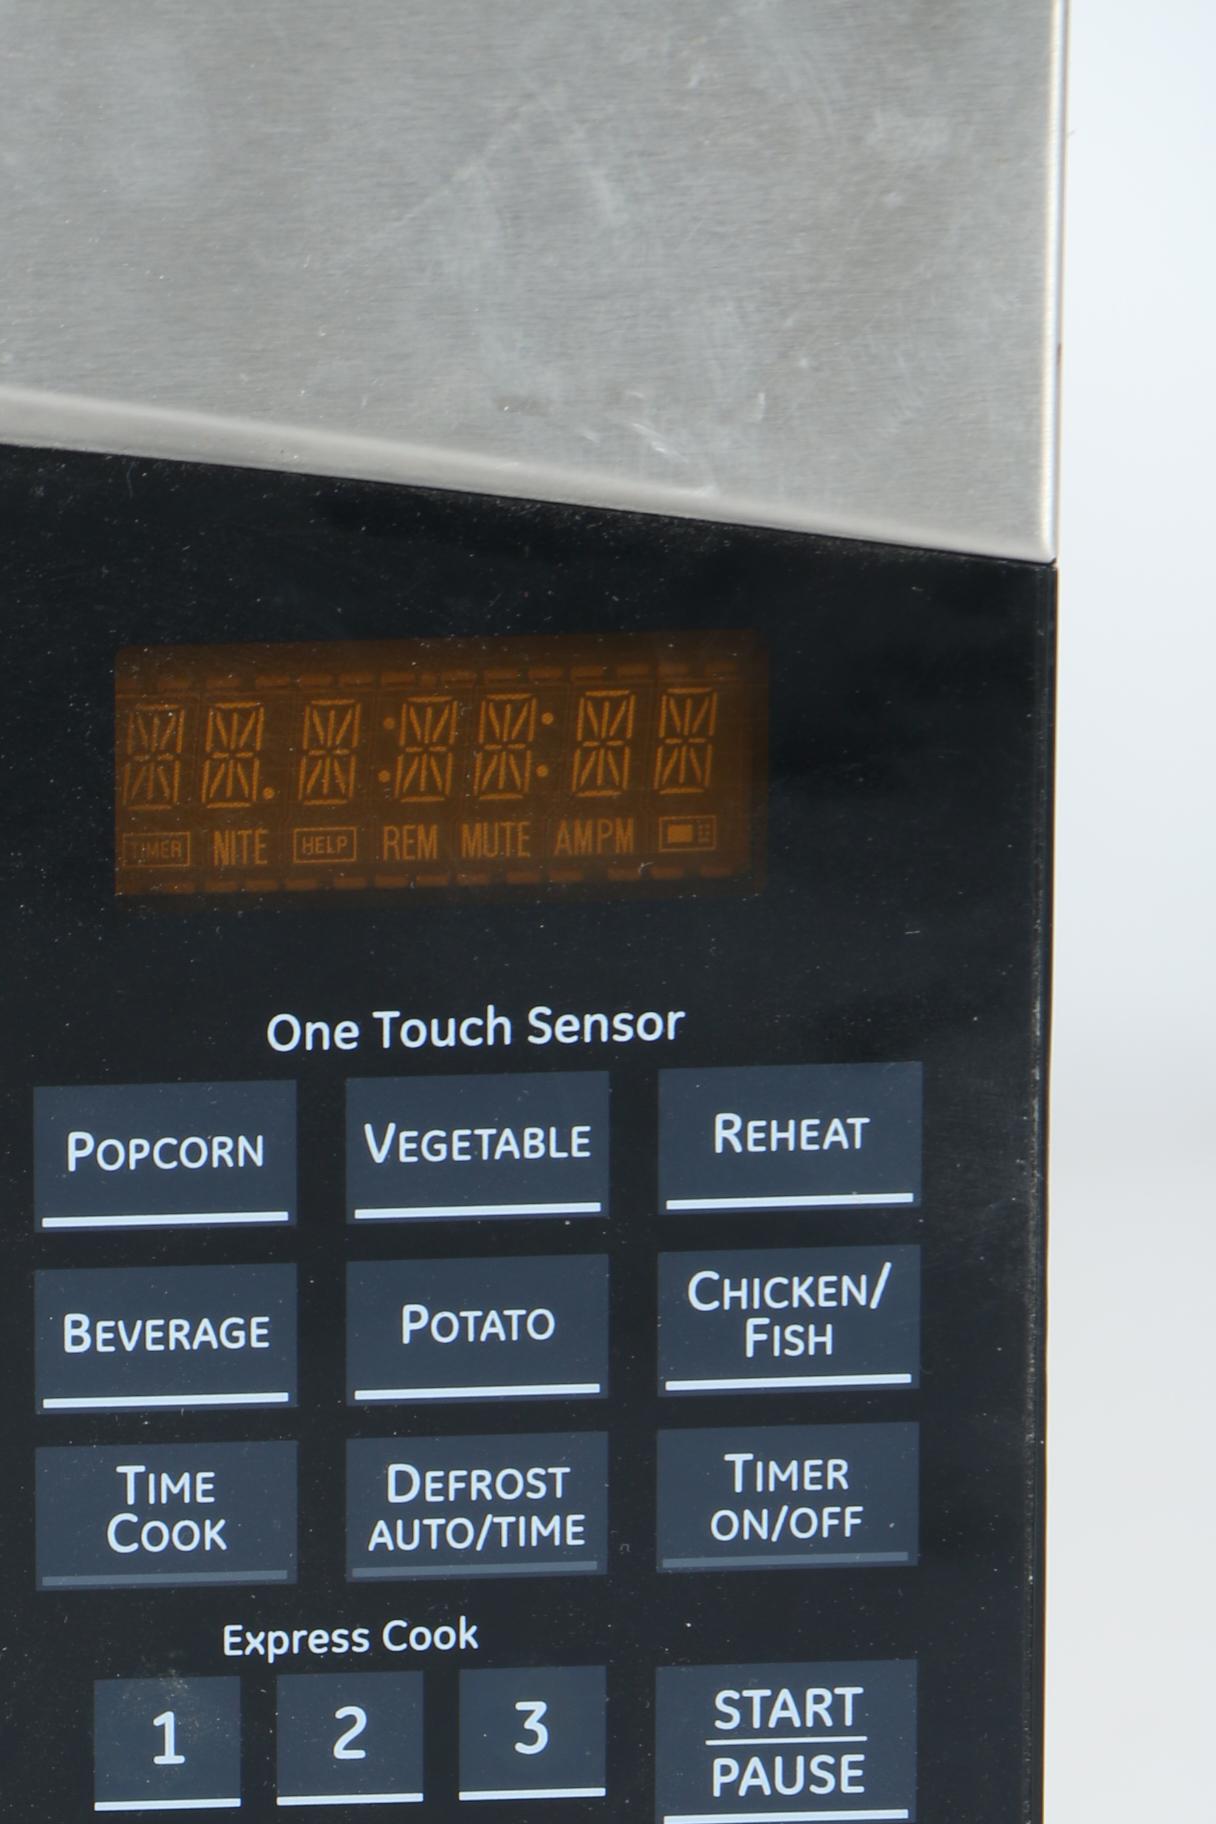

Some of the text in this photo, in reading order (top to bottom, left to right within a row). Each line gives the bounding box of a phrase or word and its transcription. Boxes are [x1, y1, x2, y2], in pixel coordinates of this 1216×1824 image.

[212, 828, 269, 867] NITE
[300, 832, 349, 856] HELP
[383, 823, 439, 861] REM
[460, 820, 532, 859] MUTE
[266, 1003, 687, 1053] One Touch Sensor
[66, 1130, 265, 1173] POPCORN
[363, 1121, 592, 1165] VEGETABLE
[713, 1111, 872, 1155] REHEAT
[686, 1260, 893, 1313] CHICKEN/
[62, 1311, 271, 1355] BEVERAGE
[401, 1302, 557, 1346] POTATO
[744, 1316, 834, 1359] FISH
[114, 1463, 217, 1507] TIME
[386, 1462, 572, 1505] DEFROST
[722, 1451, 850, 1494] TIMER
[105, 1511, 229, 1555] COOK
[366, 1512, 587, 1553] AUTO/TIME
[709, 1503, 865, 1544] ON/OFF
[222, 1614, 480, 1664] Express Cook
[513, 1699, 550, 1756] 3
[713, 1685, 866, 1731] START
[151, 1709, 187, 1766] 1
[332, 1704, 369, 1761] 2
[711, 1752, 867, 1799] PAUSE
